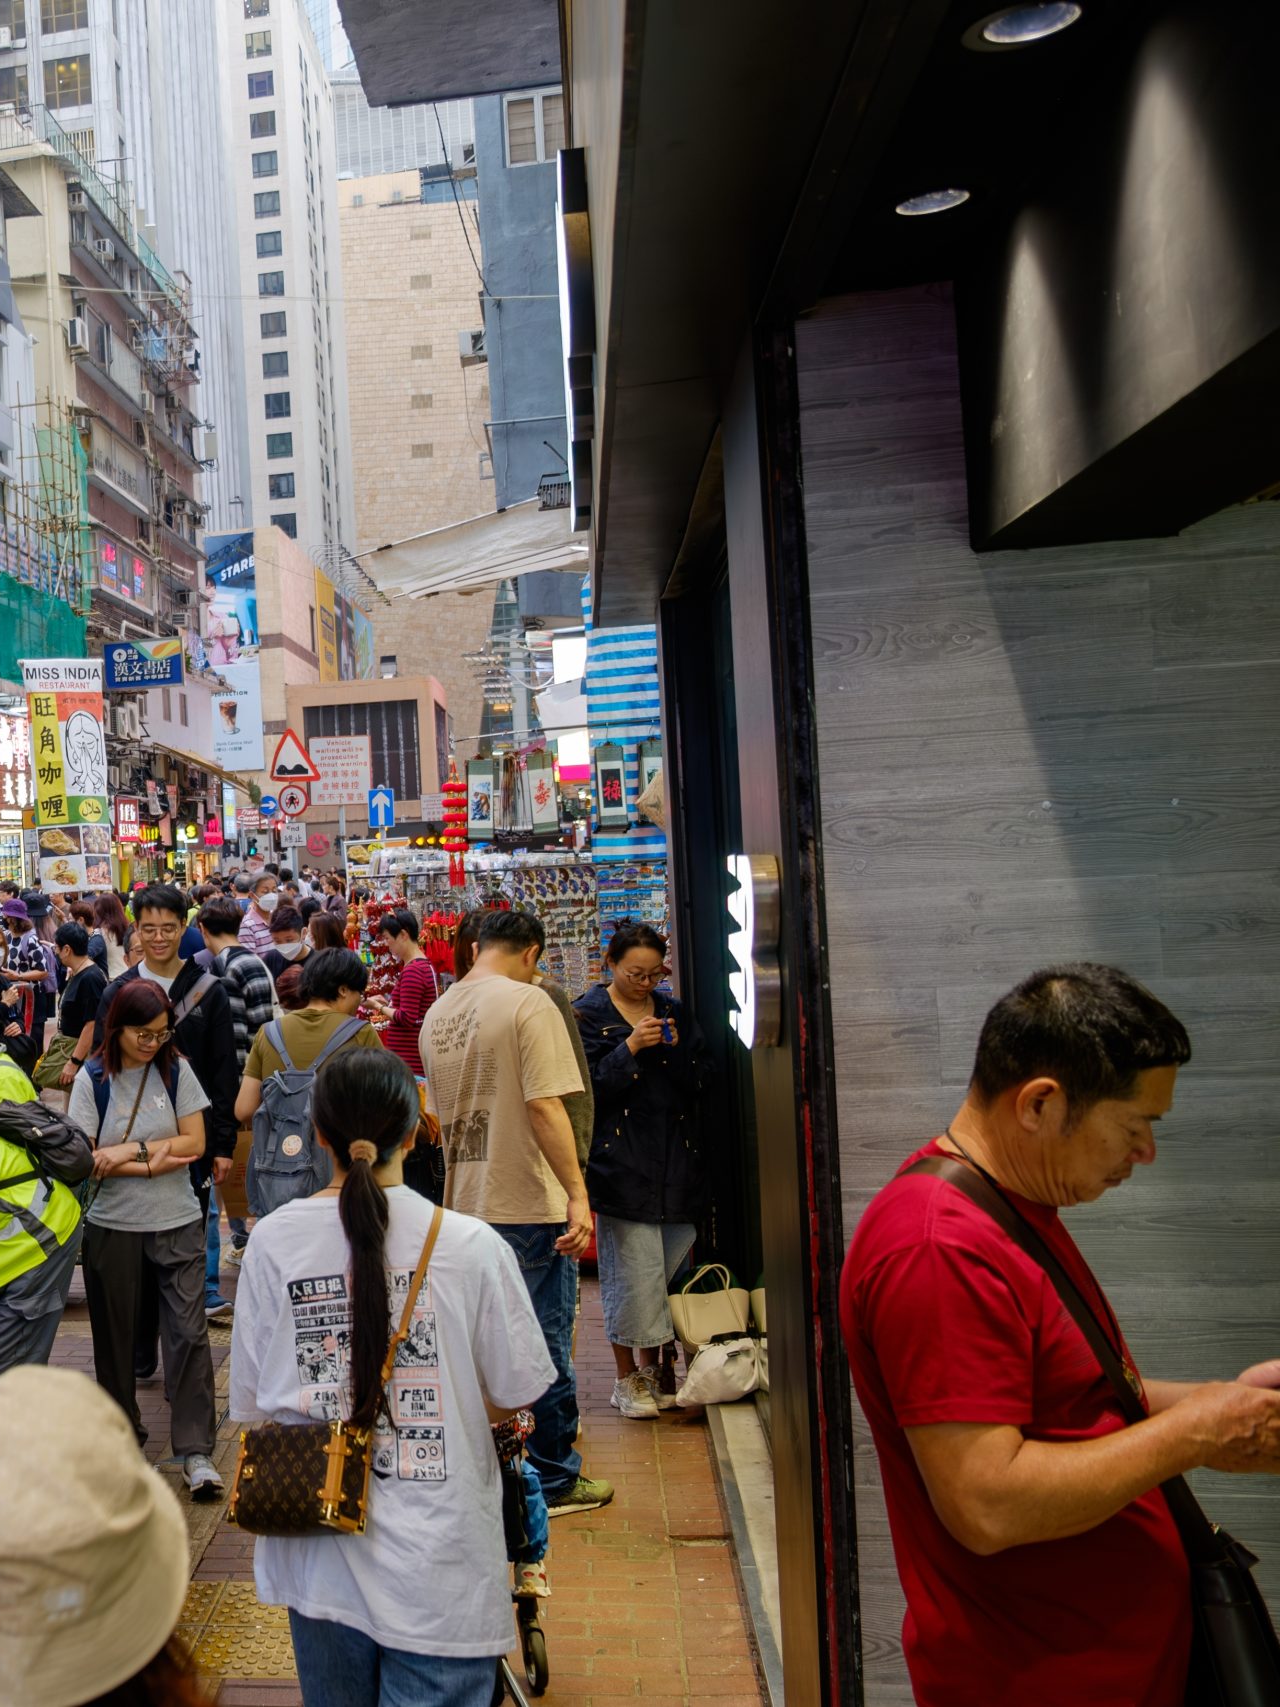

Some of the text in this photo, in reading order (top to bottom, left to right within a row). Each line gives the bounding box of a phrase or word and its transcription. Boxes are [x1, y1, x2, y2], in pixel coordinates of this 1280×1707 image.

[25, 667, 101, 680] MISS INDIA
[114, 659, 171, 677] 漢文書店
[38, 681, 91, 690] RESTAURANT
[34, 697, 66, 819] 旺角咖喱
[81, 801, 101, 817] حلال
[291, 1278, 343, 1298] 人民日报
[394, 1275, 407, 1286] VS
[399, 1388, 435, 1402] 广告位
